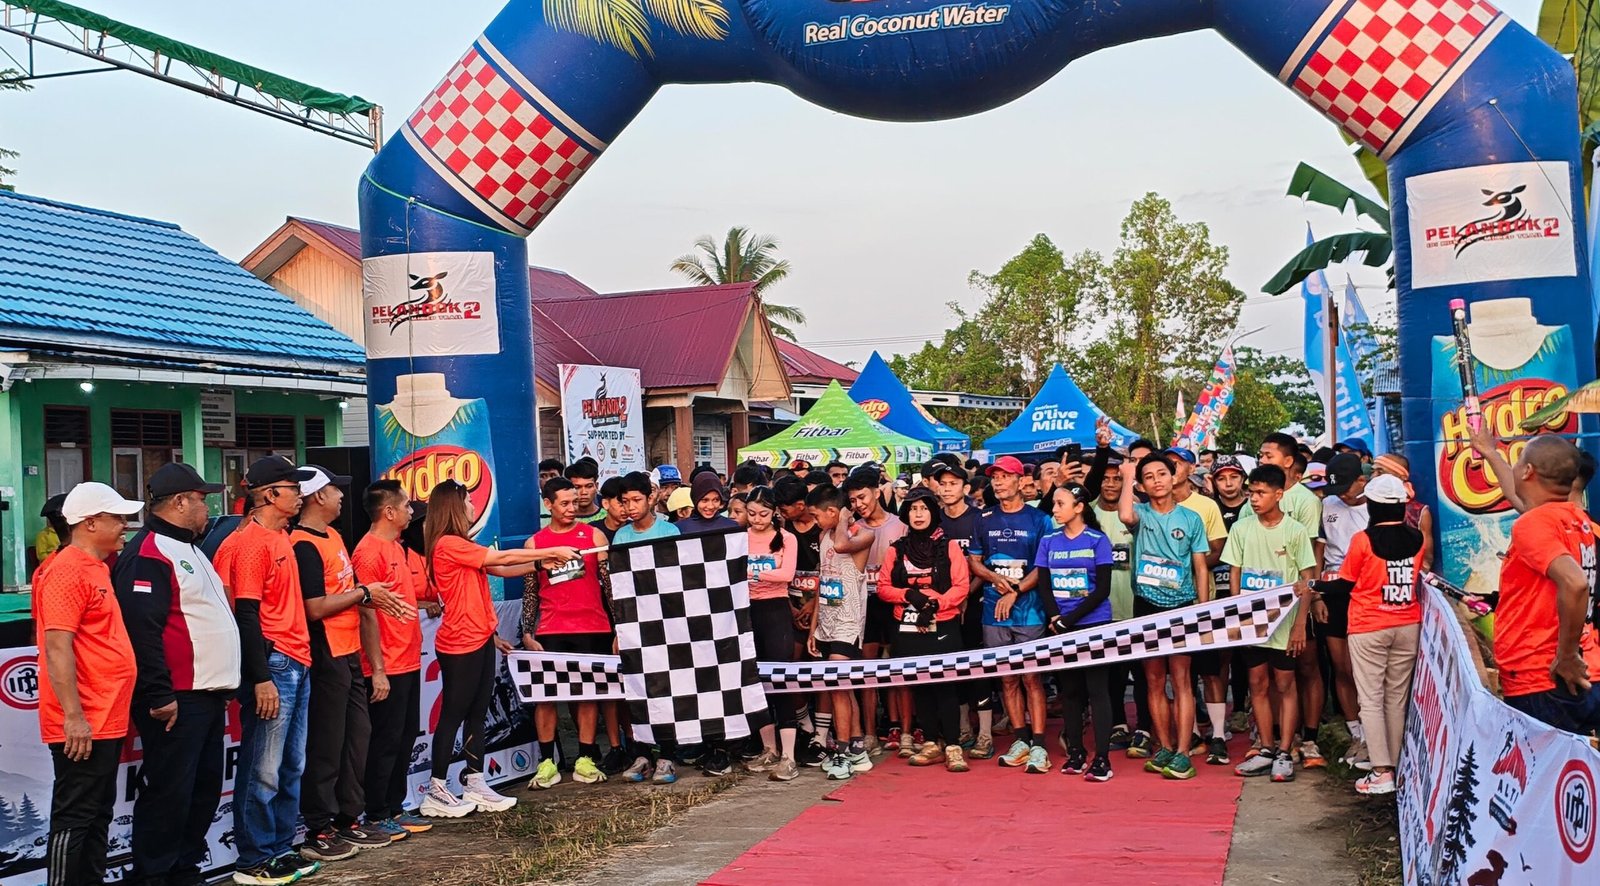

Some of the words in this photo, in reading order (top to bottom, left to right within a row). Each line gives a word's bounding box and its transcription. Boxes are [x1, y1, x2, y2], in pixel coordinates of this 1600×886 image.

[804, 17, 848, 44] Real
[850, 10, 941, 38] Coconut
[942, 5, 1010, 28] Water
[1543, 217, 1560, 237] 2
[463, 301, 481, 319] 2
[793, 426, 852, 438] Fitbar
[1031, 419, 1076, 432] Milk
[587, 430, 619, 440] SUPPORTED
[795, 453, 819, 461] Fitbar
[845, 451, 869, 459] Fitbar
[1143, 564, 1178, 579] 0010
[1388, 566, 1413, 584] THE
[1247, 576, 1276, 589] 0011
[1497, 779, 1519, 804] ALTI
